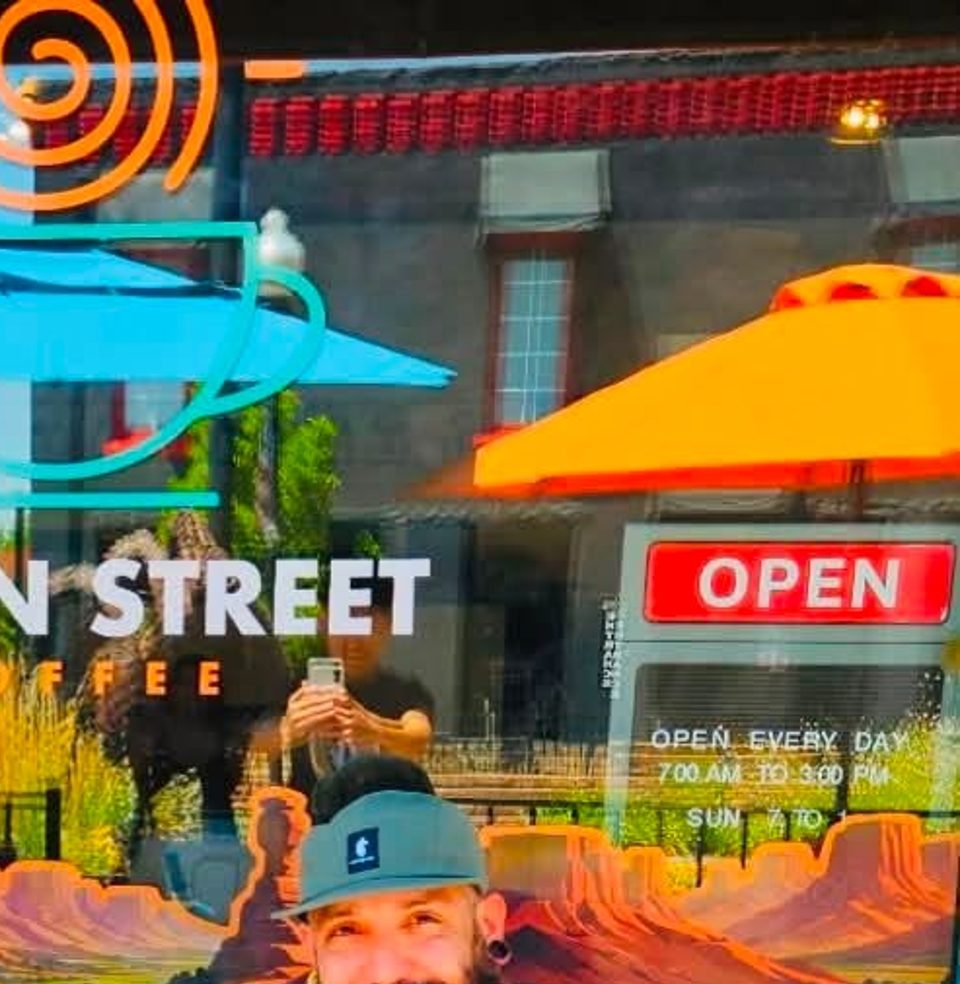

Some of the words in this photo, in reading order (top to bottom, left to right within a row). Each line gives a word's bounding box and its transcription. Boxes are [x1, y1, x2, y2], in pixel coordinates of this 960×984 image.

[698, 557, 901, 611] OPEN
[90, 558, 432, 637] STREET
[651, 729, 730, 749] OPEN
[749, 730, 837, 751] EVERY
[855, 731, 909, 752] DAY
[705, 764, 740, 784] AM
[759, 765, 787, 784] TO
[852, 766, 889, 785] PM
[687, 808, 739, 828] SUN
[796, 810, 822, 828] TO
